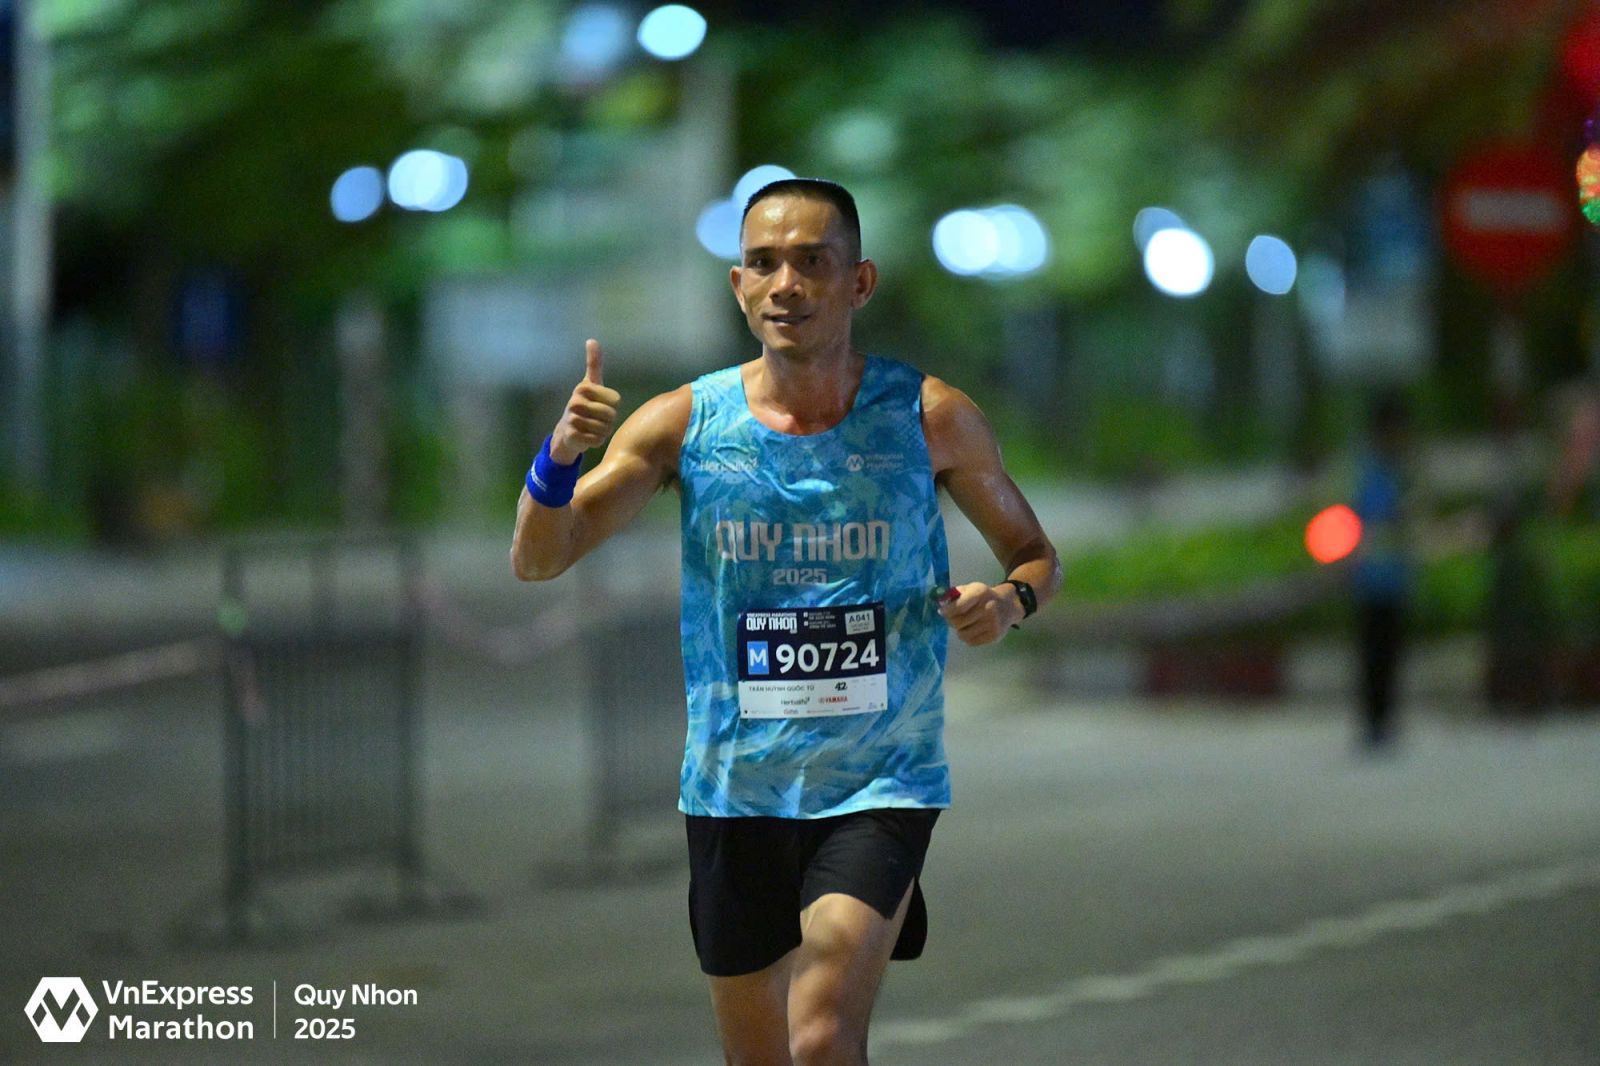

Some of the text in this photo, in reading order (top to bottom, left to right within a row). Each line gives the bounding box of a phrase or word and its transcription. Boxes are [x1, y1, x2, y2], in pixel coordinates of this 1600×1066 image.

[715, 520, 783, 563] QUY
[773, 568, 828, 586] 2025
[746, 617, 767, 631] QUY
[849, 612, 870, 624] A041
[749, 648, 767, 667] M
[775, 638, 880, 674] 90724
[834, 681, 848, 691] 42
